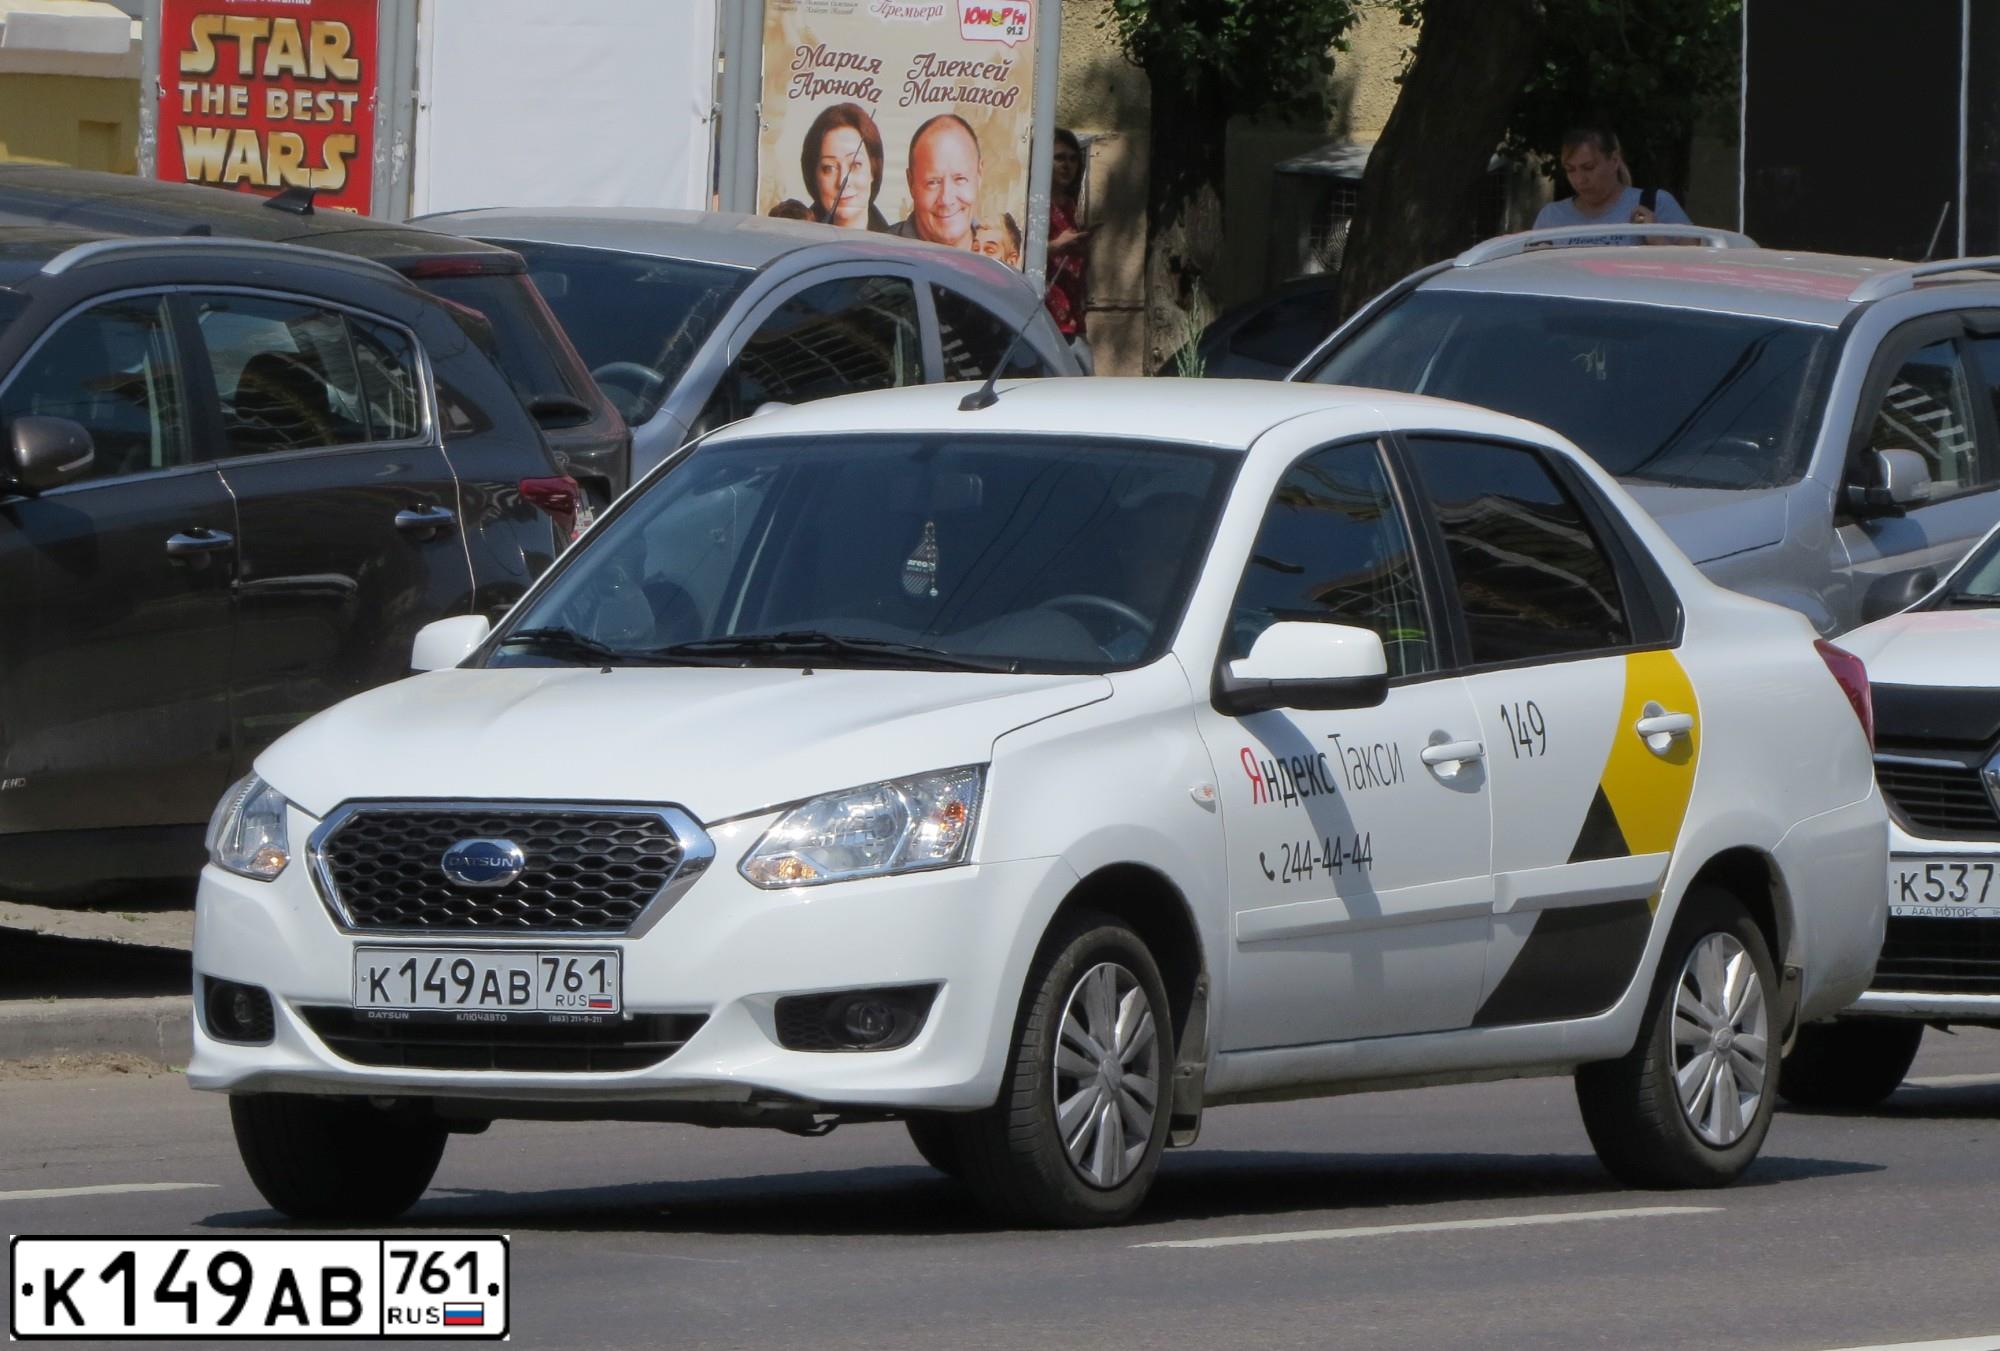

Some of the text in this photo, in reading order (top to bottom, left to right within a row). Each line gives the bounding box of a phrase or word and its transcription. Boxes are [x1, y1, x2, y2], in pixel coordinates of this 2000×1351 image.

[870, 0, 944, 21] Премьера
[180, 14, 359, 80] STAR
[791, 43, 883, 75] Мария
[906, 52, 1013, 82] Алексей
[178, 81, 358, 122] THE BEST
[788, 71, 883, 103] Аронова
[899, 78, 1019, 109] Маклаков
[178, 126, 356, 190] WARS
[1500, 700, 1546, 758] 149
[1240, 733, 1405, 808] Яндекс Такси
[1281, 832, 1373, 883] 244-44-44
[1900, 864, 1994, 903] К537
[370, 957, 606, 1005] К149АВ 761
[555, 994, 588, 1007] RUS
[368, 1011, 409, 1020] DATSUN
